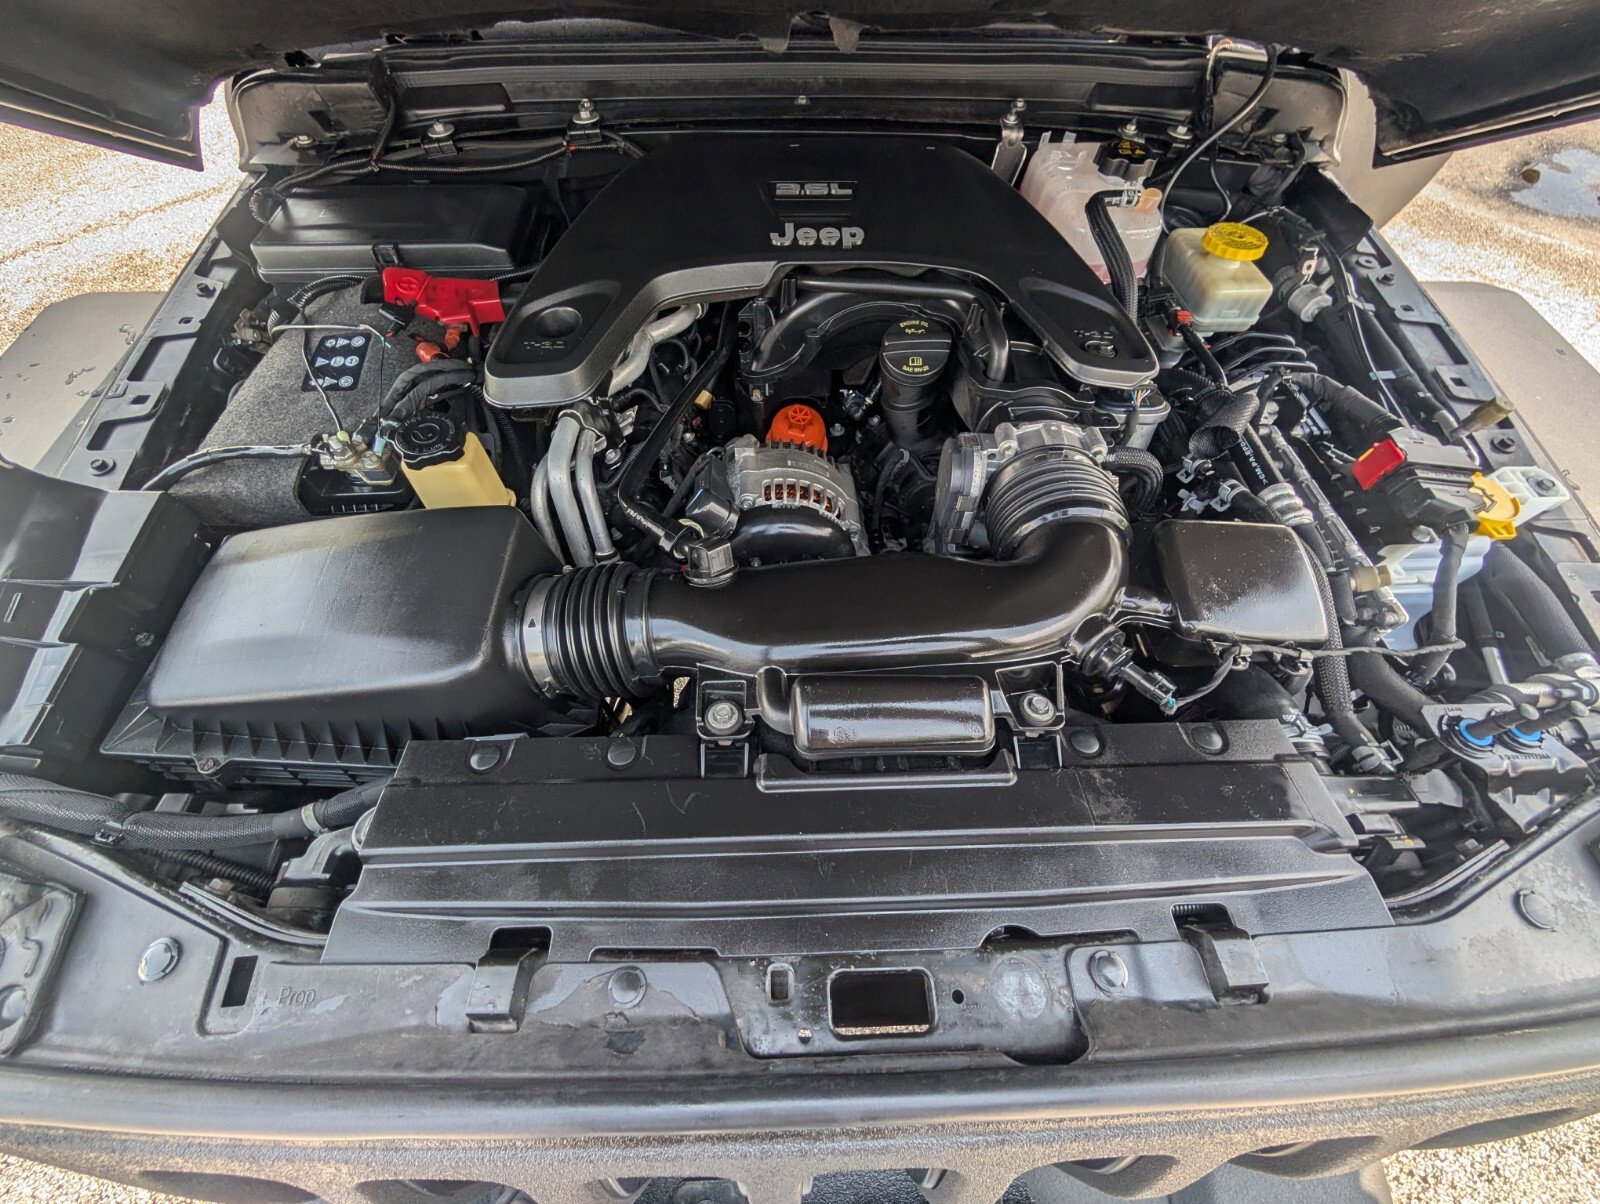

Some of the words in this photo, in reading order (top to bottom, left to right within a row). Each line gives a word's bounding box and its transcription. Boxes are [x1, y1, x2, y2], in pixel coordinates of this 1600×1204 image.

[776, 183, 853, 195] 3.6L
[770, 222, 865, 249] Jeep
[899, 320, 919, 328] ENGINE
[902, 365, 913, 373] SAE
[278, 985, 316, 1008] Prop
